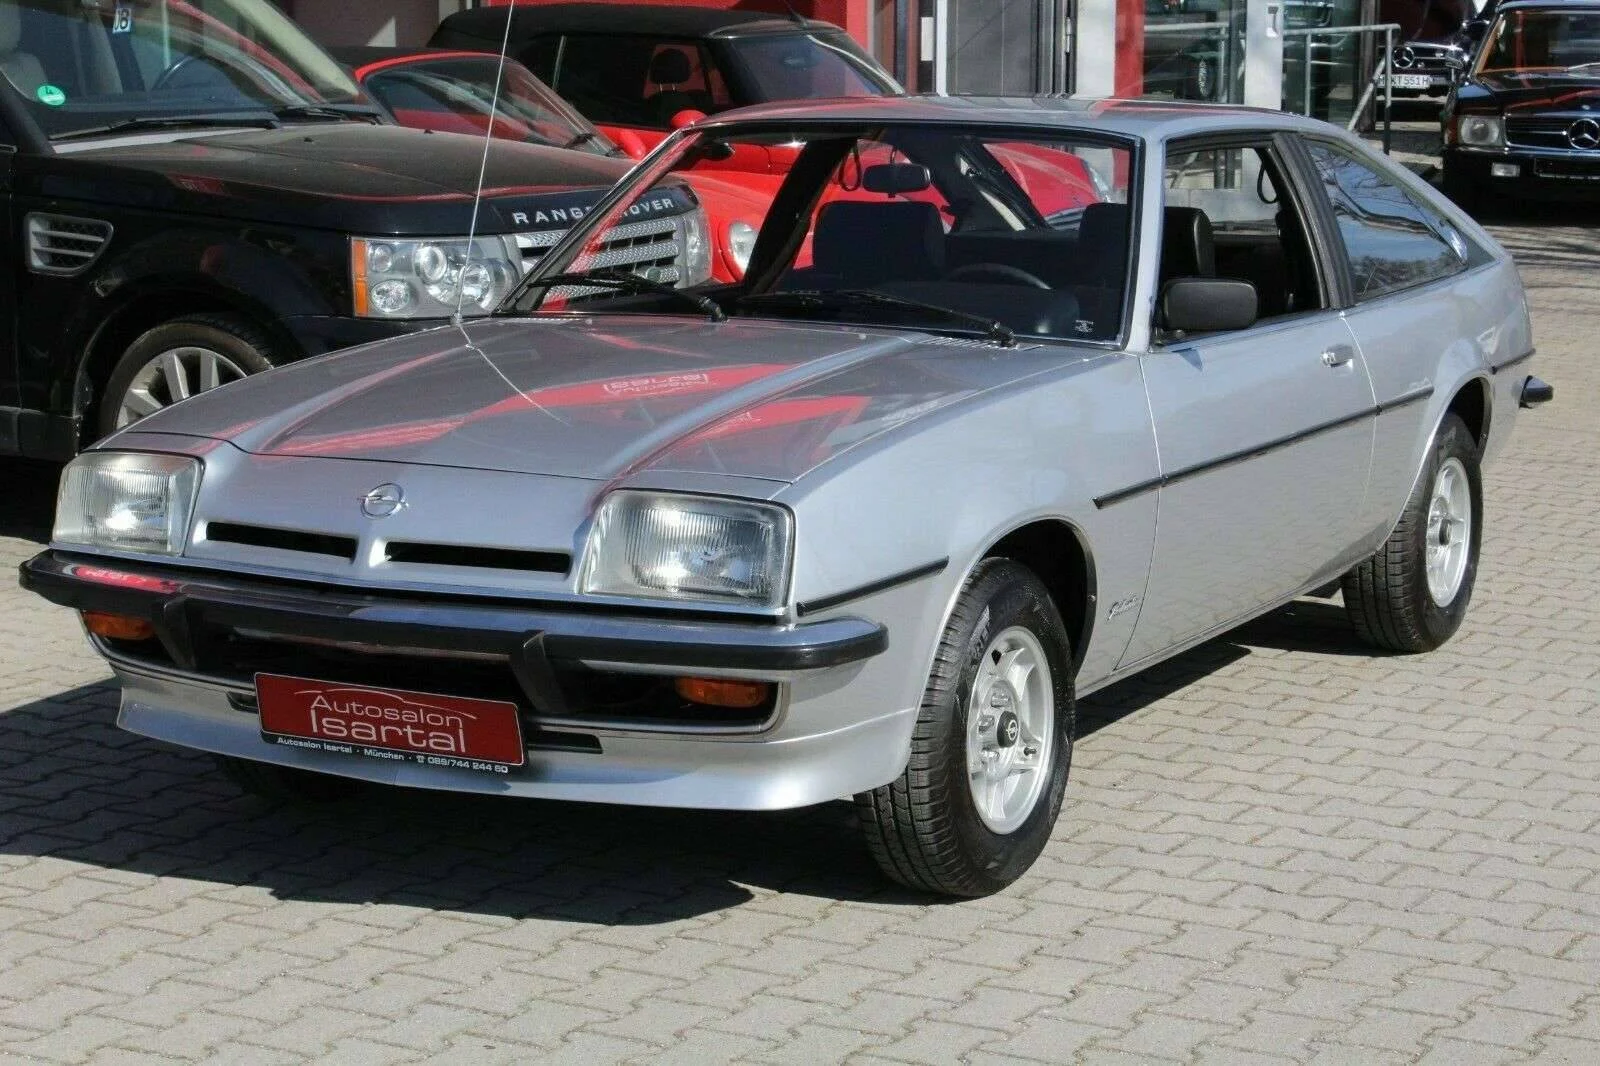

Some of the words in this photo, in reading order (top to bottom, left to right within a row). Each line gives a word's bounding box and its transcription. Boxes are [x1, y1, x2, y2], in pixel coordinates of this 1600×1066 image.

[622, 198, 674, 217] OVER
[310, 694, 463, 730] Autosalon
[310, 706, 466, 754] Isartal
[277, 737, 321, 750] Autosalon
[323, 743, 352, 754] Isartal
[363, 748, 405, 761] München
